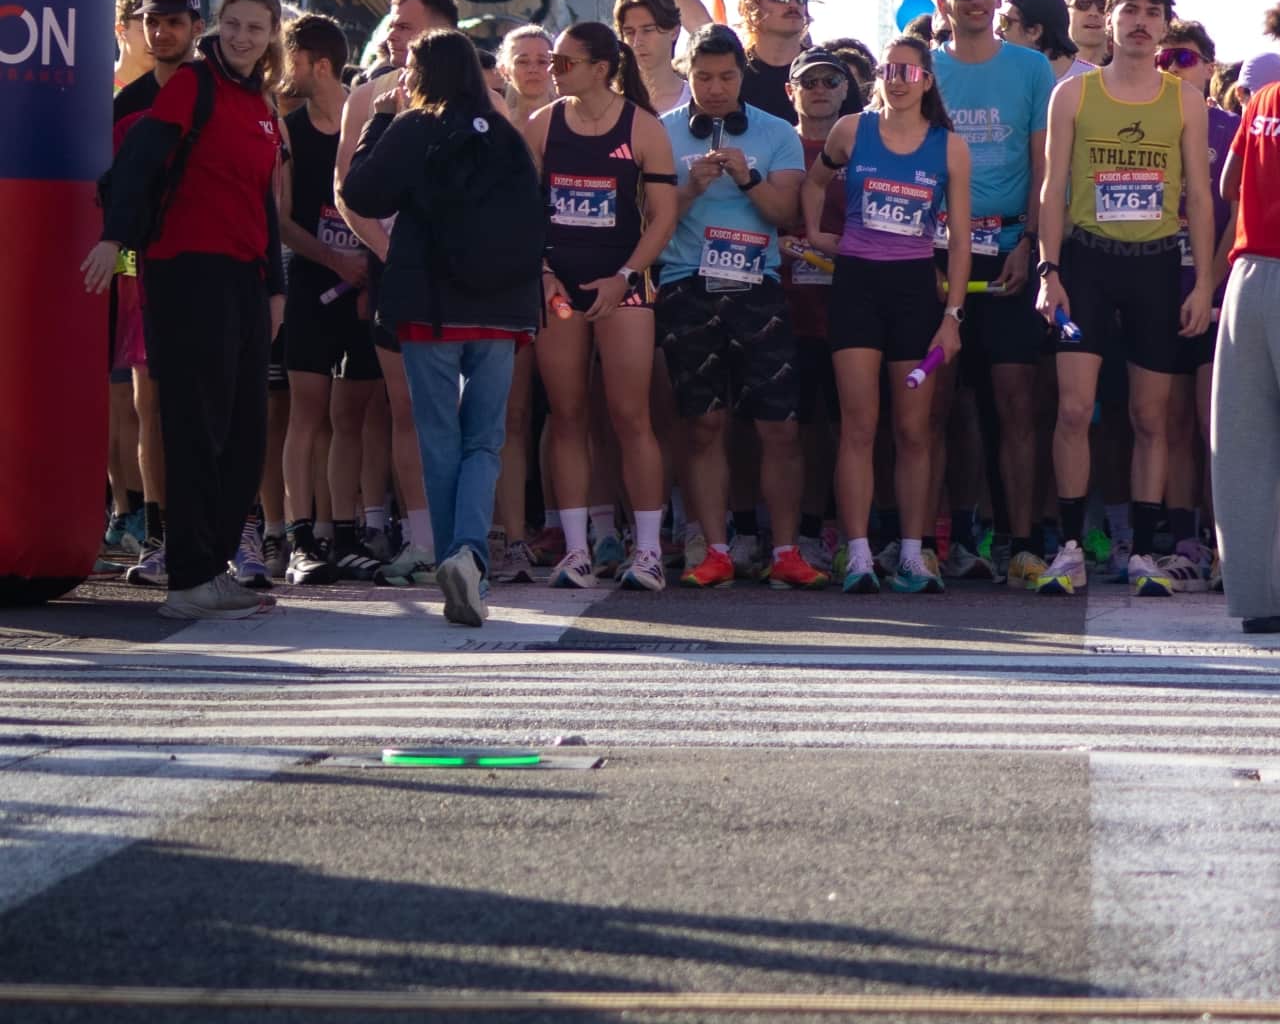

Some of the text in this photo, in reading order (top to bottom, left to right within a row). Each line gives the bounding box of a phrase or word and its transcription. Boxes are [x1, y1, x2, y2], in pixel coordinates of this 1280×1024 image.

[1089, 147, 1168, 169] ATHLETICS
[555, 197, 609, 216] 414-1
[1102, 192, 1158, 209] 176-1
[865, 201, 922, 225] 446-1
[707, 249, 761, 272] 089-1
